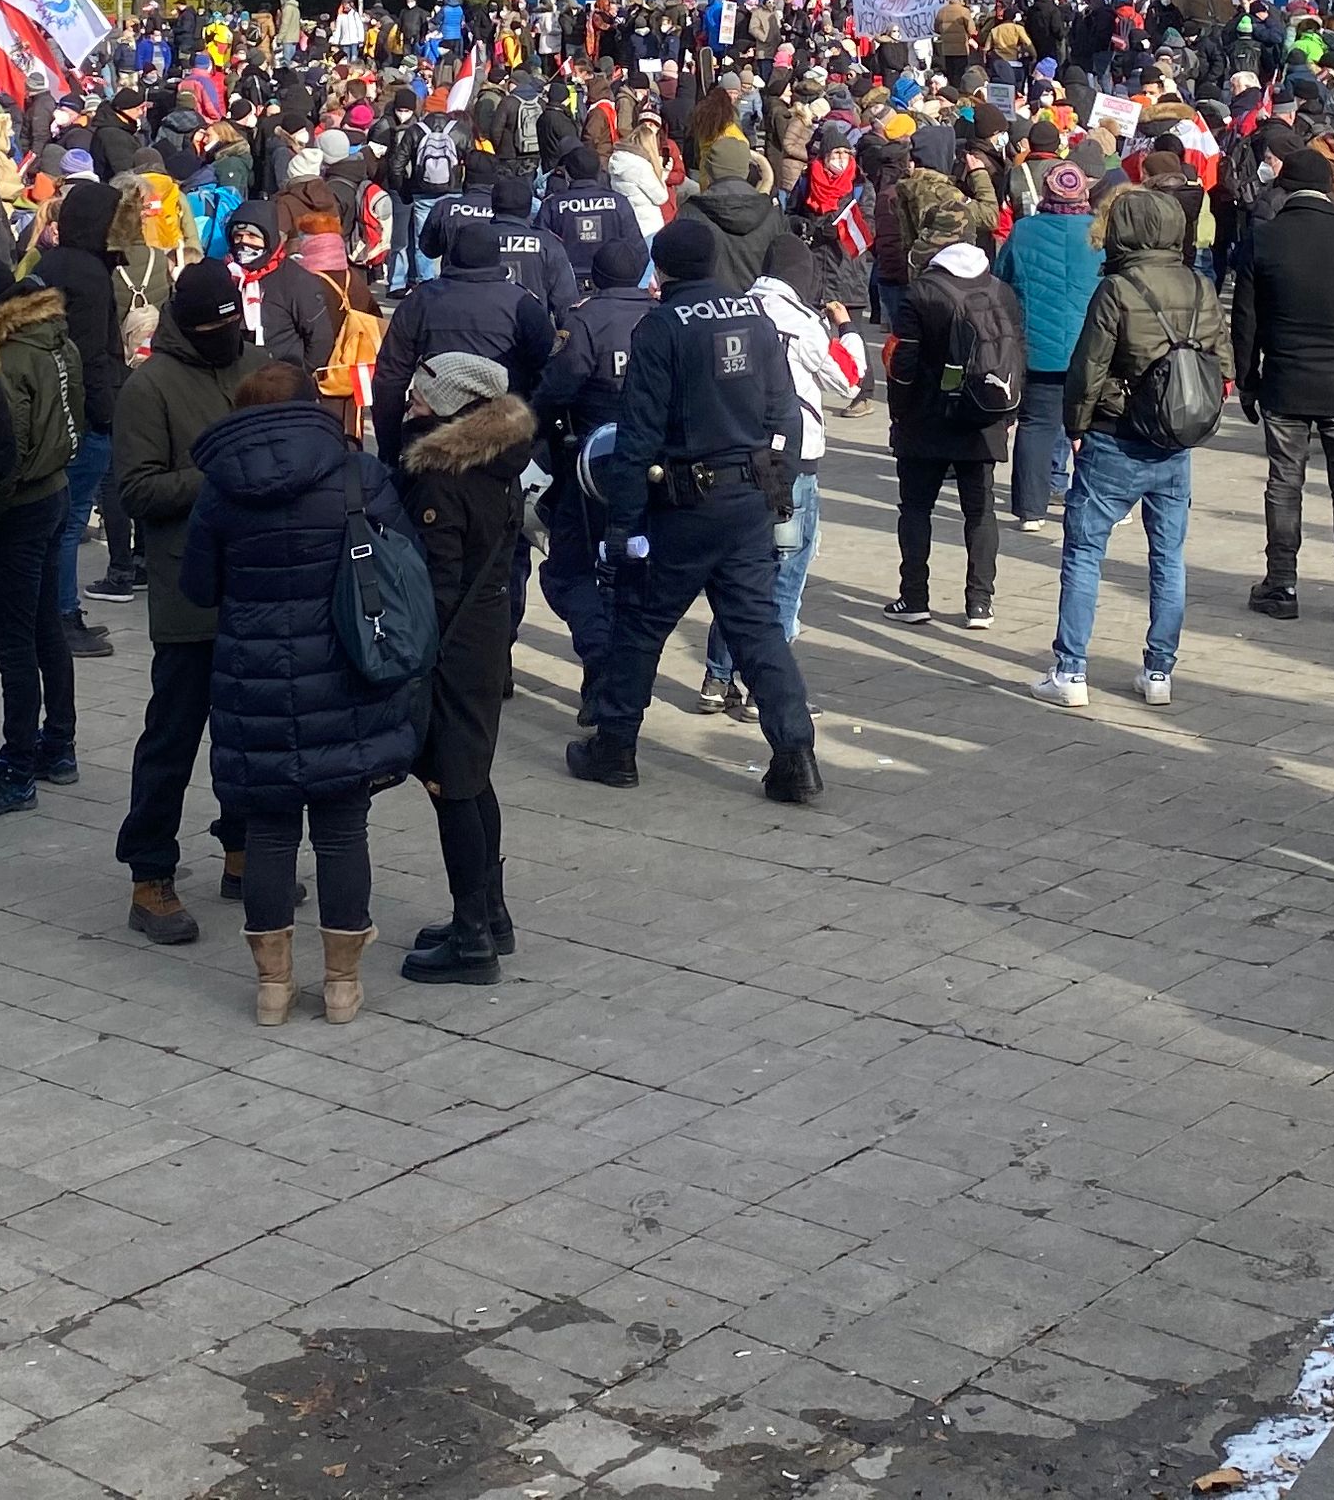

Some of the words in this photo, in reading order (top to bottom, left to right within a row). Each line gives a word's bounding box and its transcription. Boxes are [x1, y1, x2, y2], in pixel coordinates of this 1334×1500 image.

[450, 203, 495, 218] POLIZ
[558, 197, 616, 214] POLIZEI
[582, 219, 593, 231] D
[579, 231, 597, 241] 352
[499, 236, 540, 253] LIZEI
[673, 297, 762, 325] POLIZEI
[726, 336, 742, 357] D
[723, 358, 747, 374] 352
